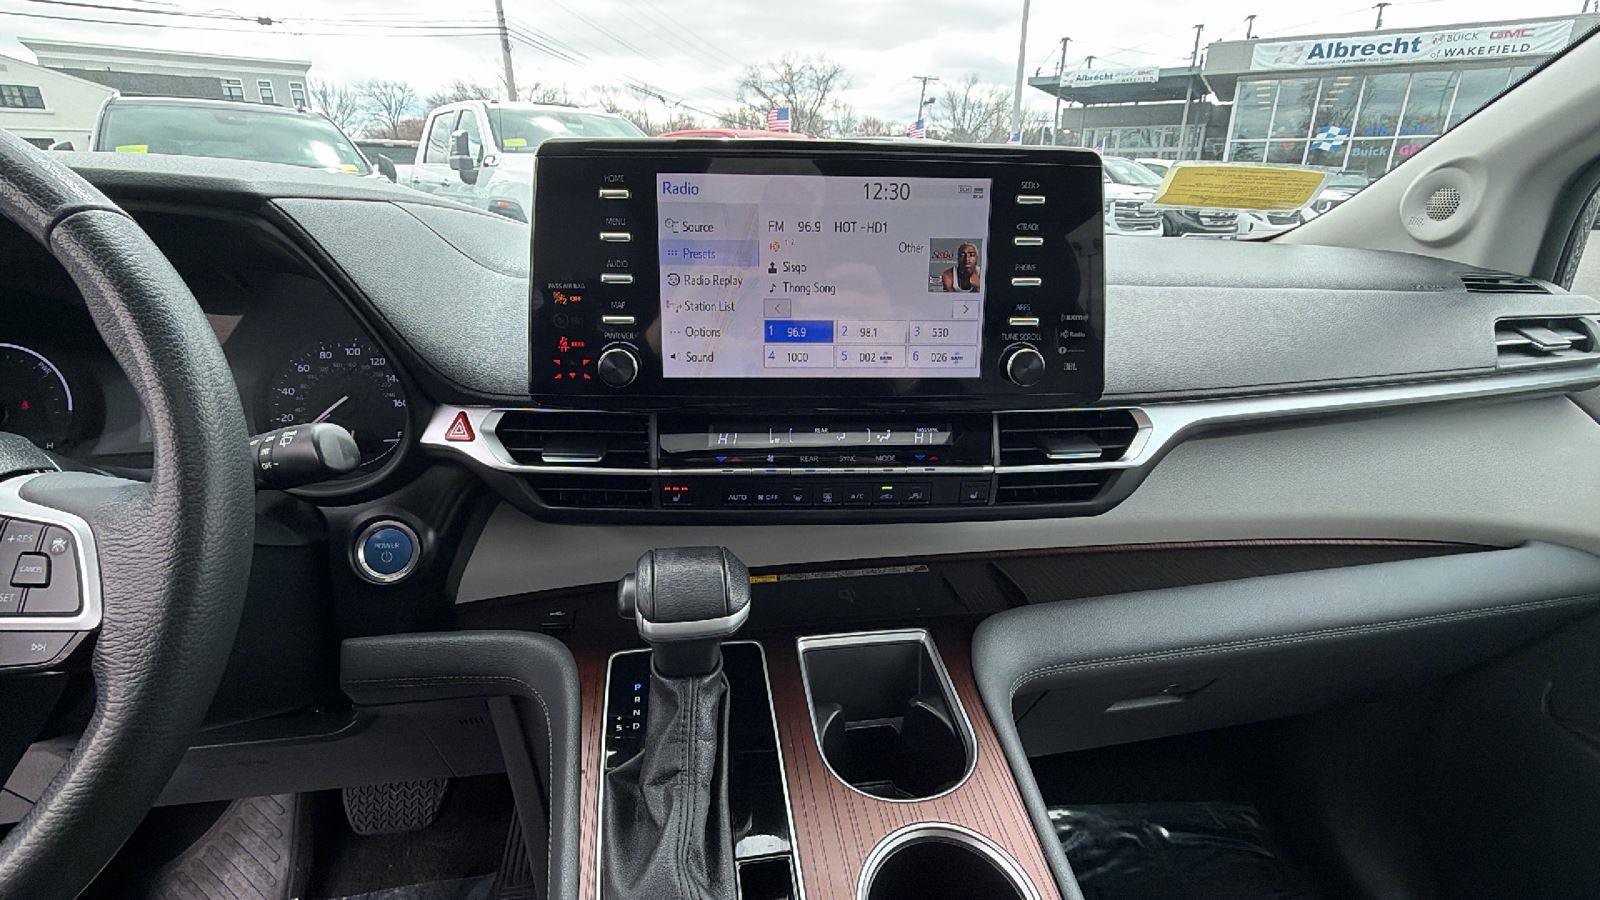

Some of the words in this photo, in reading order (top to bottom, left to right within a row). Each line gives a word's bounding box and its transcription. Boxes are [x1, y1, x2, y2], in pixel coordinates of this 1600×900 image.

[1446, 32, 1479, 43] BUICK
[1489, 28, 1535, 40] GMC
[1307, 36, 1422, 60] Albrecht
[1444, 43, 1531, 58] WAKEFIELD
[1076, 71, 1114, 81] Albrecht
[1352, 146, 1387, 156] Buick
[662, 181, 699, 195] Radio
[863, 182, 911, 201] 12:30
[606, 217, 626, 226] MENU
[682, 221, 714, 233] Source
[768, 221, 784, 232] FM
[797, 221, 821, 233] 96.9
[834, 221, 857, 233] HOT
[898, 241, 924, 253] Other
[683, 248, 716, 259] Presets
[606, 259, 629, 268] AUDIO
[782, 261, 807, 274] Sisqo
[1015, 263, 1037, 271] PHONE
[684, 274, 710, 286] Radio
[712, 274, 743, 288] Replay
[782, 281, 811, 296] Thong
[813, 281, 836, 296] Song
[610, 301, 626, 310] MAP
[684, 300, 716, 312] Station
[719, 300, 736, 312] List
[1016, 303, 1031, 311] APPS
[685, 326, 721, 338] Options
[768, 324, 774, 336] 1
[787, 327, 807, 338] 96.9
[841, 325, 848, 337] 2
[859, 327, 878, 338] 98.1
[914, 326, 921, 337] 3
[931, 327, 949, 338] 530
[320, 351, 332, 359] 80
[345, 347, 361, 356] 100
[686, 351, 714, 363] Sound
[768, 350, 775, 361] 4
[787, 352, 809, 363] 1000
[841, 350, 848, 362] 5
[859, 352, 876, 363] 002
[912, 350, 920, 362] 6
[931, 352, 948, 363] 026
[370, 357, 386, 366] 120
[297, 364, 310, 373] 60
[281, 387, 295, 396] 40
[281, 413, 294, 422] 20
[634, 683, 641, 691] P
[632, 722, 640, 730] D
